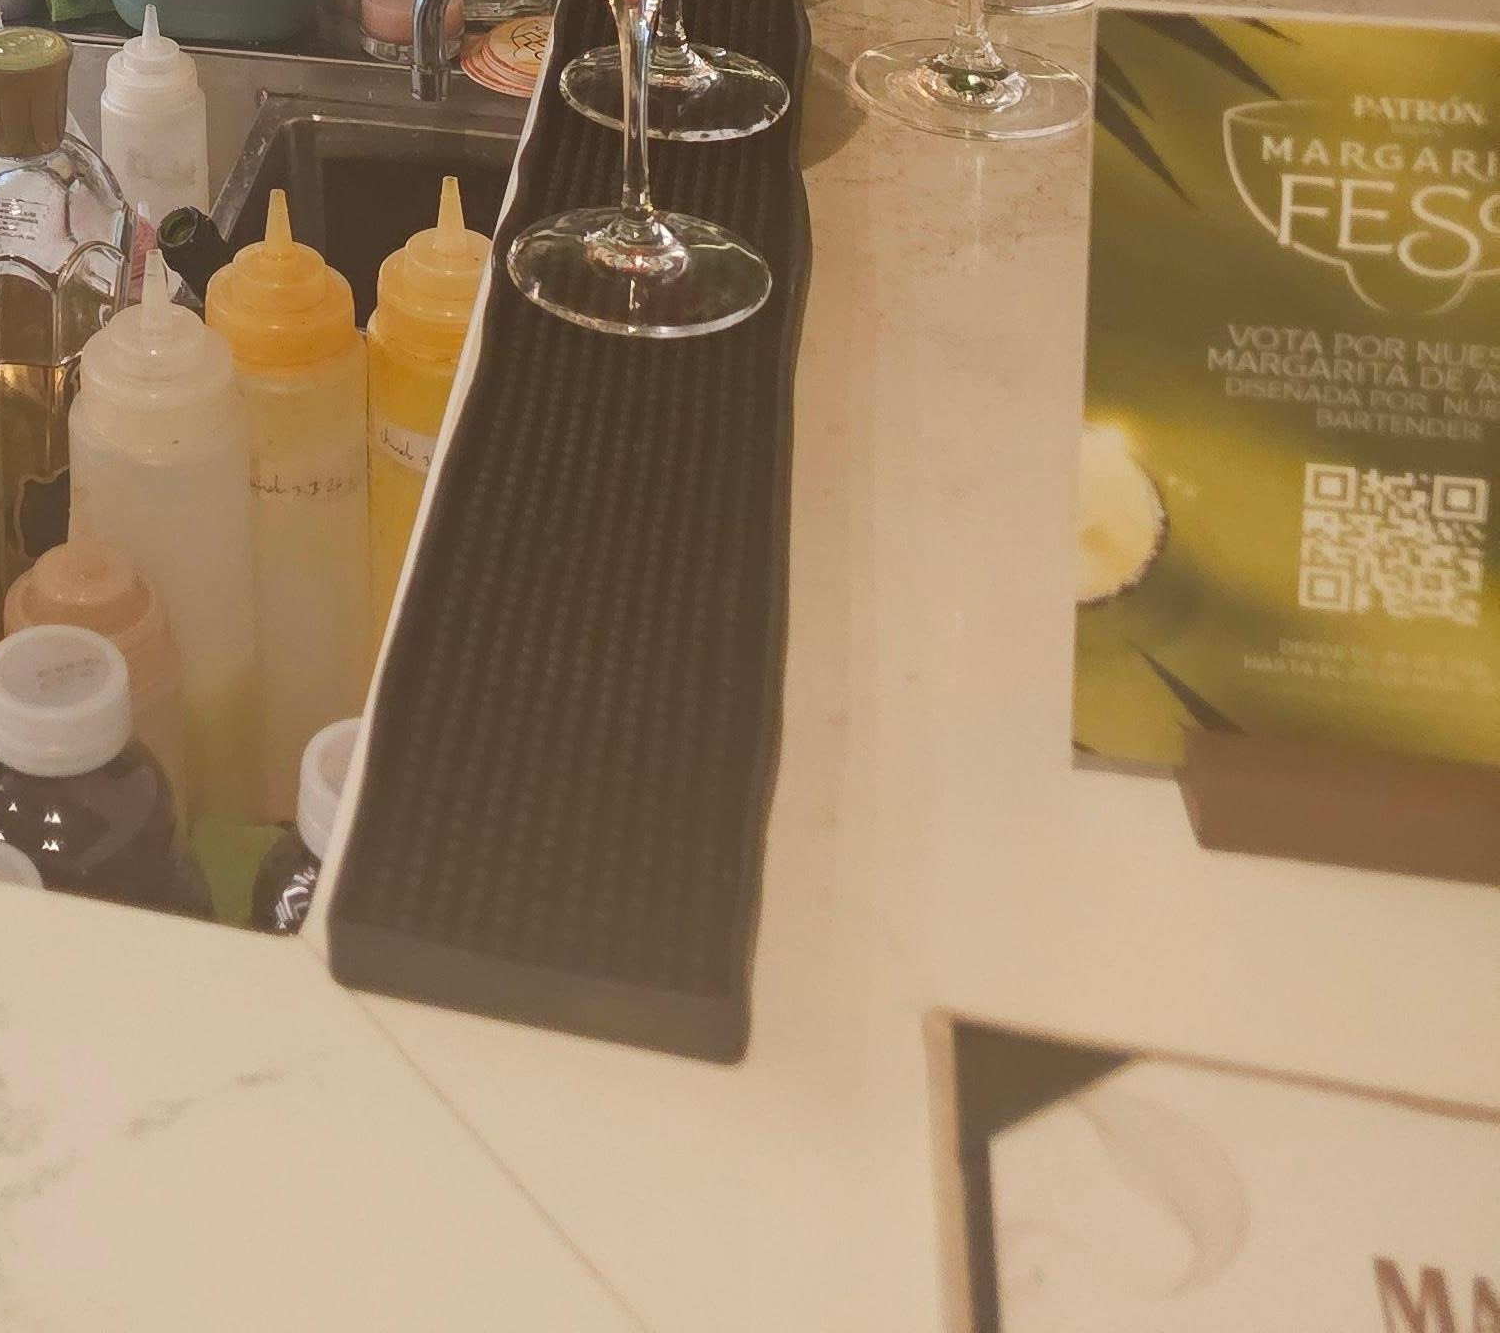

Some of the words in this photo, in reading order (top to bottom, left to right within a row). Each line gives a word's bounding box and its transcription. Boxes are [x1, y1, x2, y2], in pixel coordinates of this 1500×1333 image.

[1353, 95, 1488, 126] PATRÓN
[1227, 324, 1323, 355] VOTA
[1333, 333, 1406, 362] POR
[1207, 347, 1411, 388] MARGARITA
[1419, 365, 1463, 392] DE
[1369, 388, 1429, 413] POR
[1315, 407, 1486, 443] BARTENDER
